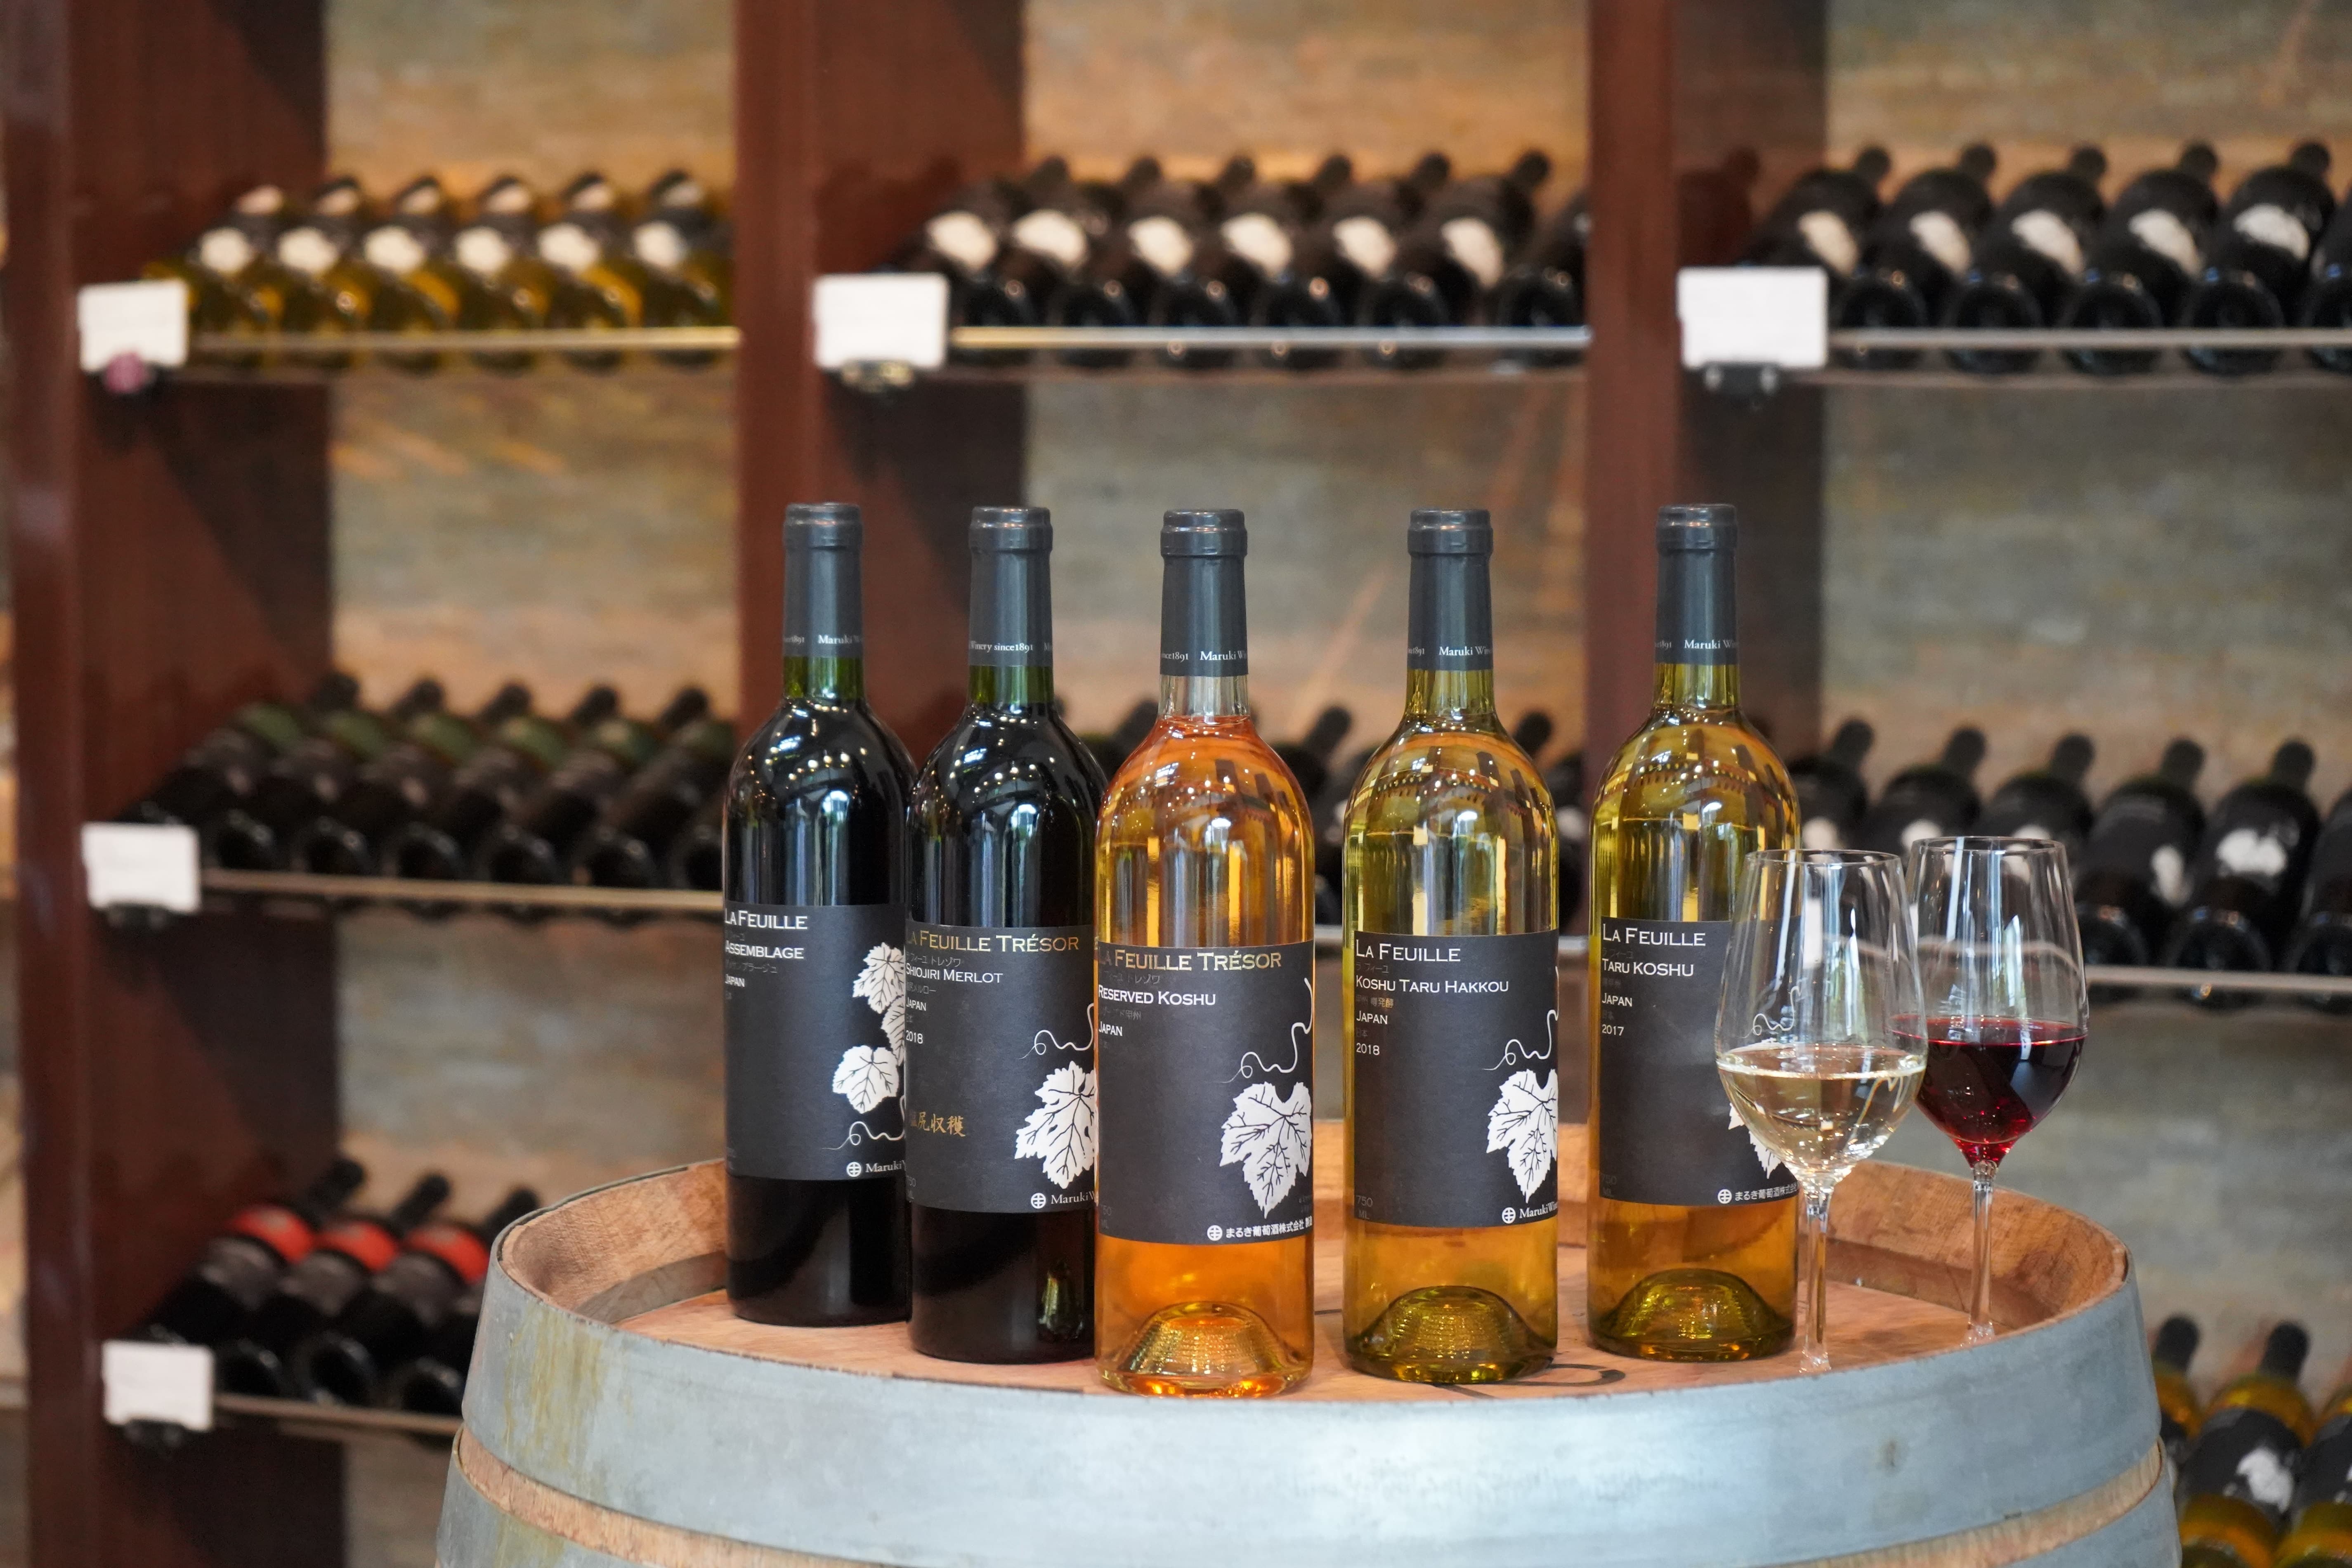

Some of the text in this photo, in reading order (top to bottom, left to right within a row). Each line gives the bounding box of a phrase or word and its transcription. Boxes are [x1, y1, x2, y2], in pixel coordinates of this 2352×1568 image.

[818, 634, 852, 644] Maruki
[1684, 638, 1720, 649] Maruki
[994, 642, 1033, 654] since1891
[1439, 646, 1473, 656] Maruki
[1199, 650, 1236, 661] Maruki
[1601, 1024, 1625, 1036] 2017
[906, 1030, 923, 1044] 2018
[1356, 1042, 1380, 1056] 2018
[865, 1160, 902, 1173] Maruki
[1051, 1192, 1088, 1204] Maruki
[1356, 1195, 1373, 1208] 750
[1519, 1203, 1548, 1219] Maruki
